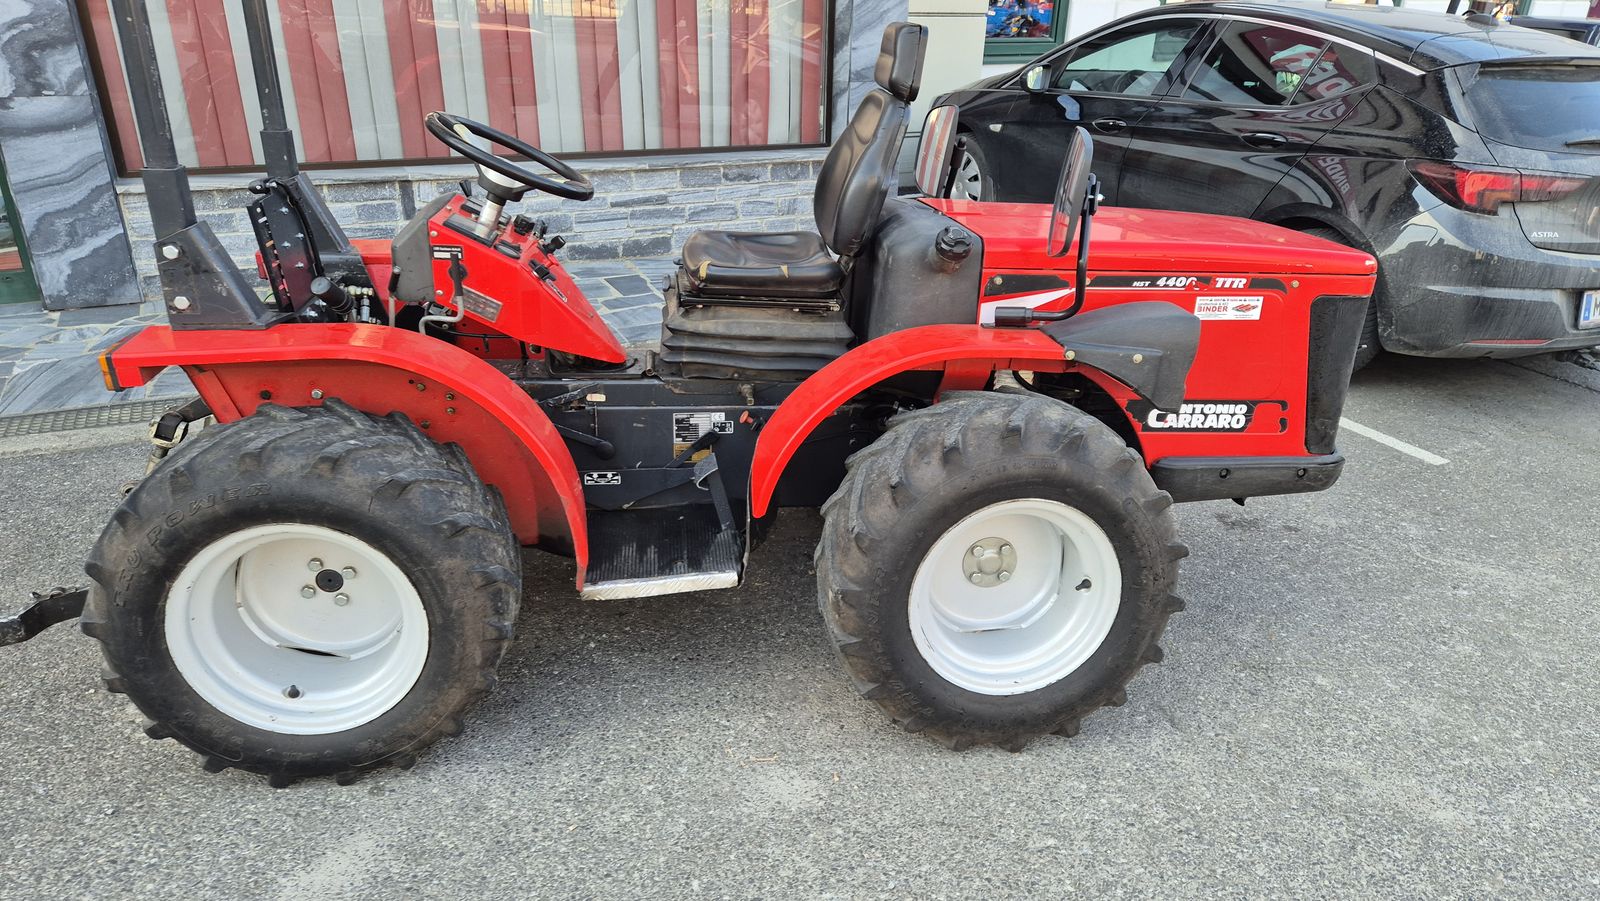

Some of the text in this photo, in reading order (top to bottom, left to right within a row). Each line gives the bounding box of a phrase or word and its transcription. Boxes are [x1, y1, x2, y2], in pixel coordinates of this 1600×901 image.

[1215, 277, 1248, 289] TTR
[1197, 305, 1229, 313] BINDER
[1178, 403, 1248, 414] NTONIO
[1147, 408, 1246, 429] CARRARO
[146, 482, 273, 552] POWER
